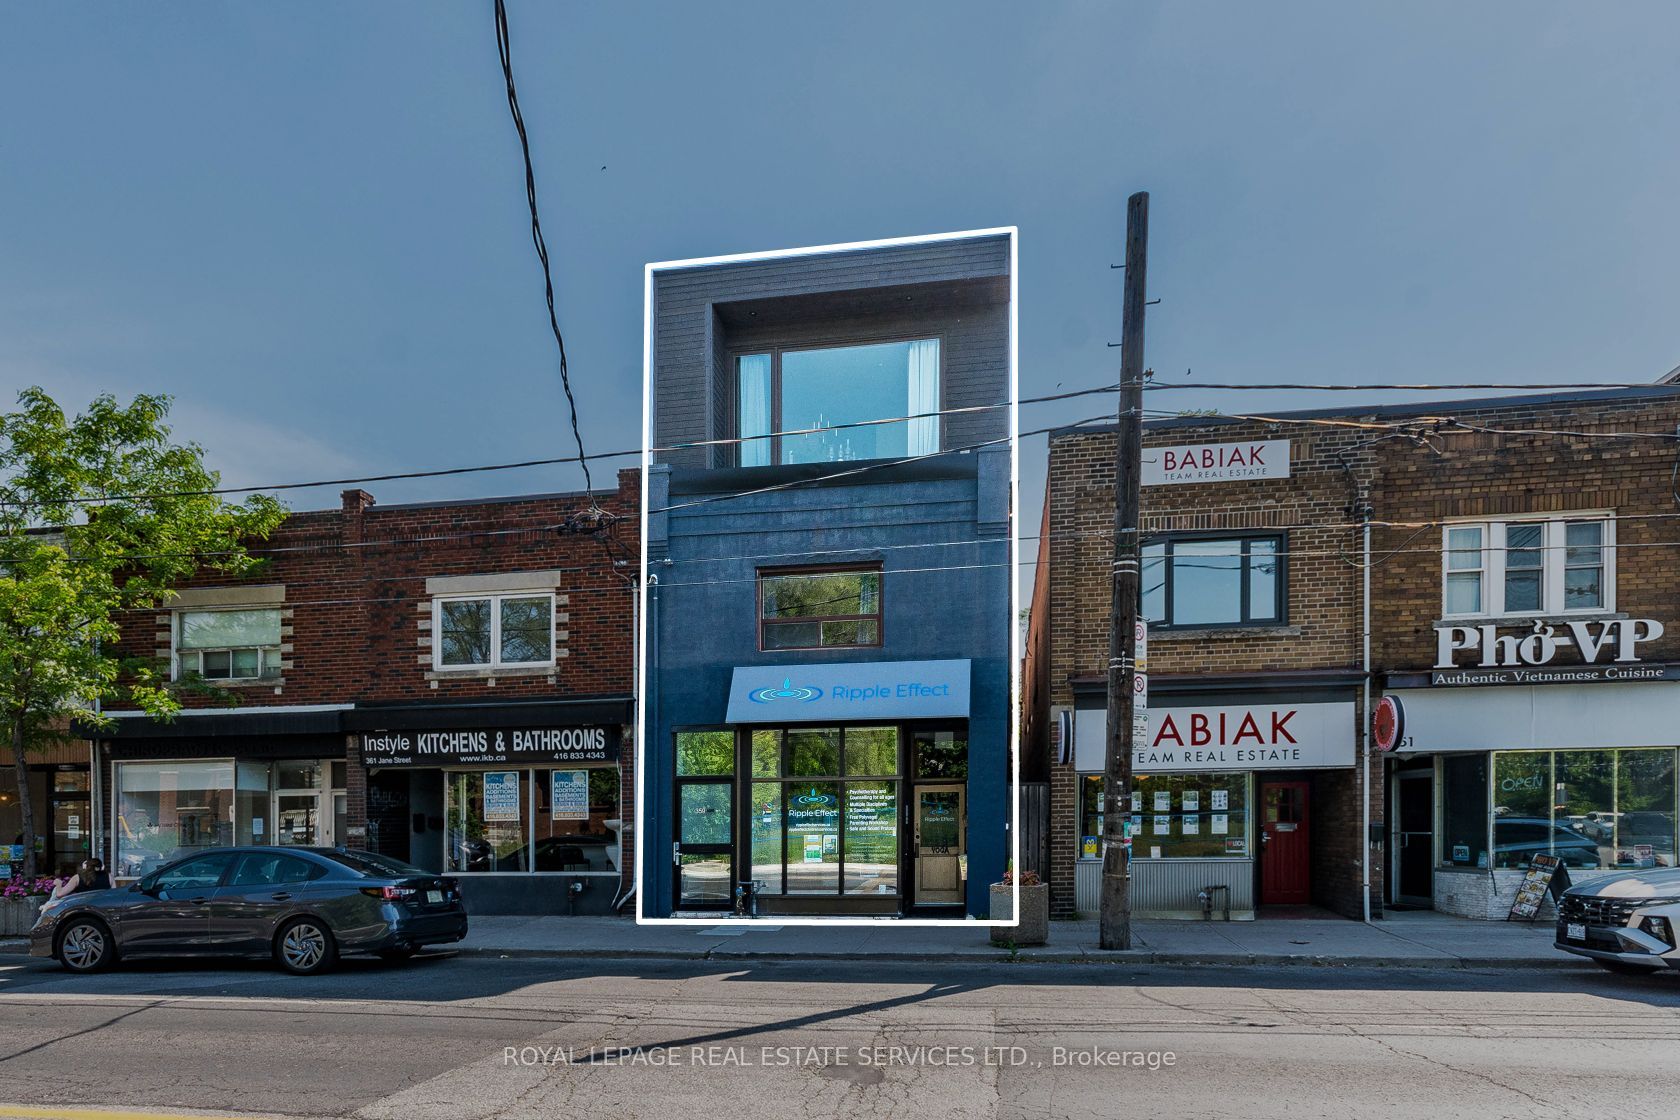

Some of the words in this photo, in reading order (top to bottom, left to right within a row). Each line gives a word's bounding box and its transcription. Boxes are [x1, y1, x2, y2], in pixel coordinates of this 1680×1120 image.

[1164, 445, 1265, 471] BABIAK
[1229, 467, 1267, 477] ESTATE
[1566, 618, 1664, 663] VP
[1434, 672, 1507, 685] Authentic
[1513, 671, 1599, 682] Vietnamese
[1605, 667, 1664, 679] Cuisine
[832, 685, 890, 701] Ripple
[896, 683, 949, 698] Effect
[1152, 710, 1298, 747] ABIAK
[364, 734, 410, 755] Instyle
[417, 731, 488, 754] KITCHENS
[495, 731, 506, 752] &
[513, 728, 606, 751] BATHROOMS
[460, 754, 506, 762] www.ikb.ca
[553, 752, 569, 760] 416
[570, 752, 585, 760] 833
[586, 751, 606, 760] 4343
[1131, 752, 1174, 764] EAM
[1184, 751, 1226, 762] REAL
[1237, 748, 1300, 761] ESTATE
[789, 810, 814, 818] Ripple
[815, 809, 837, 817] Effect
